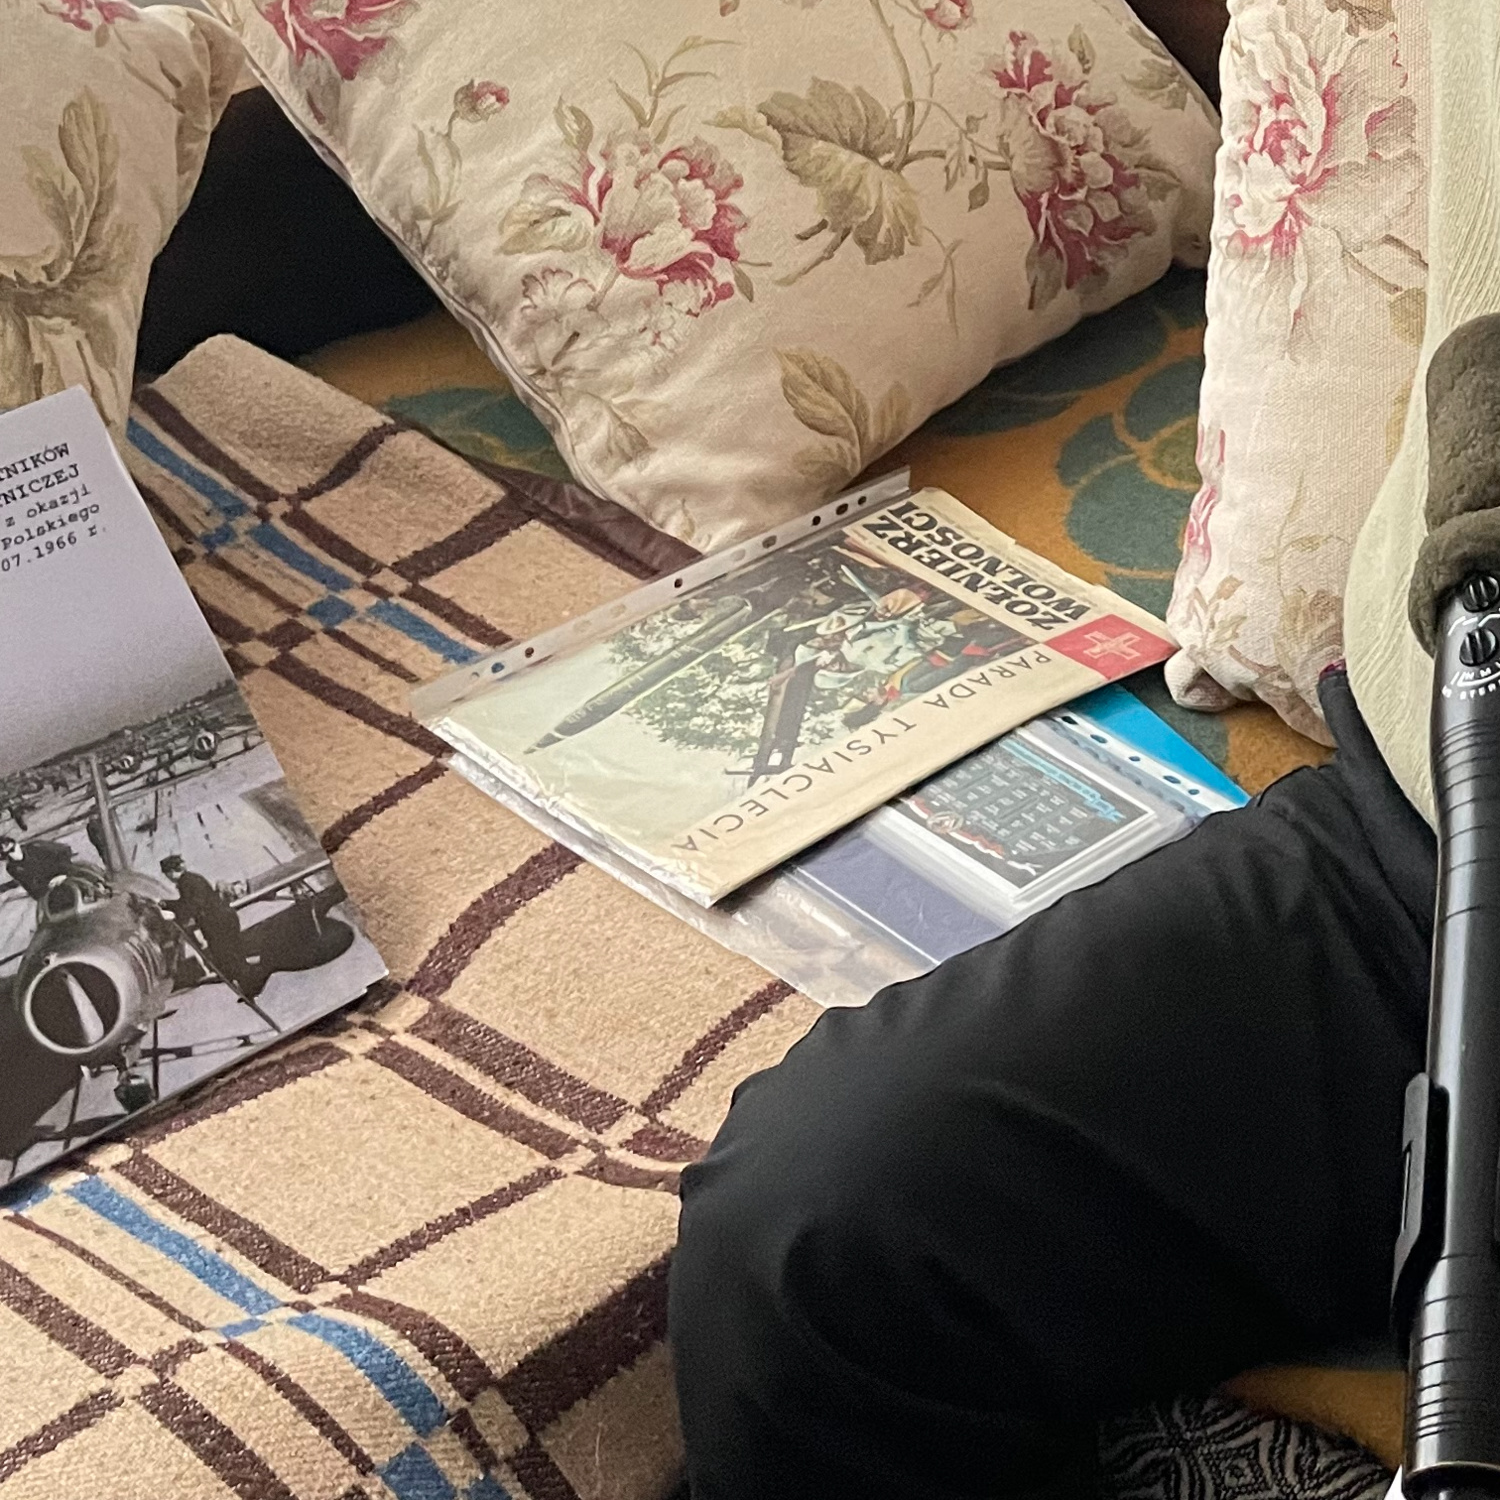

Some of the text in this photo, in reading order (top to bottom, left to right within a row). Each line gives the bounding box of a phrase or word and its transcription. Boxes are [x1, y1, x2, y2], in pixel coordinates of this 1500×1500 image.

[1, 503, 100, 551] Polskiego
[5, 483, 91, 528] z okazji
[862, 514, 1070, 631] ŻOŁNIERZ
[922, 649, 1052, 710] PARADA
[671, 716, 918, 852] TYSIĄCLECIA
